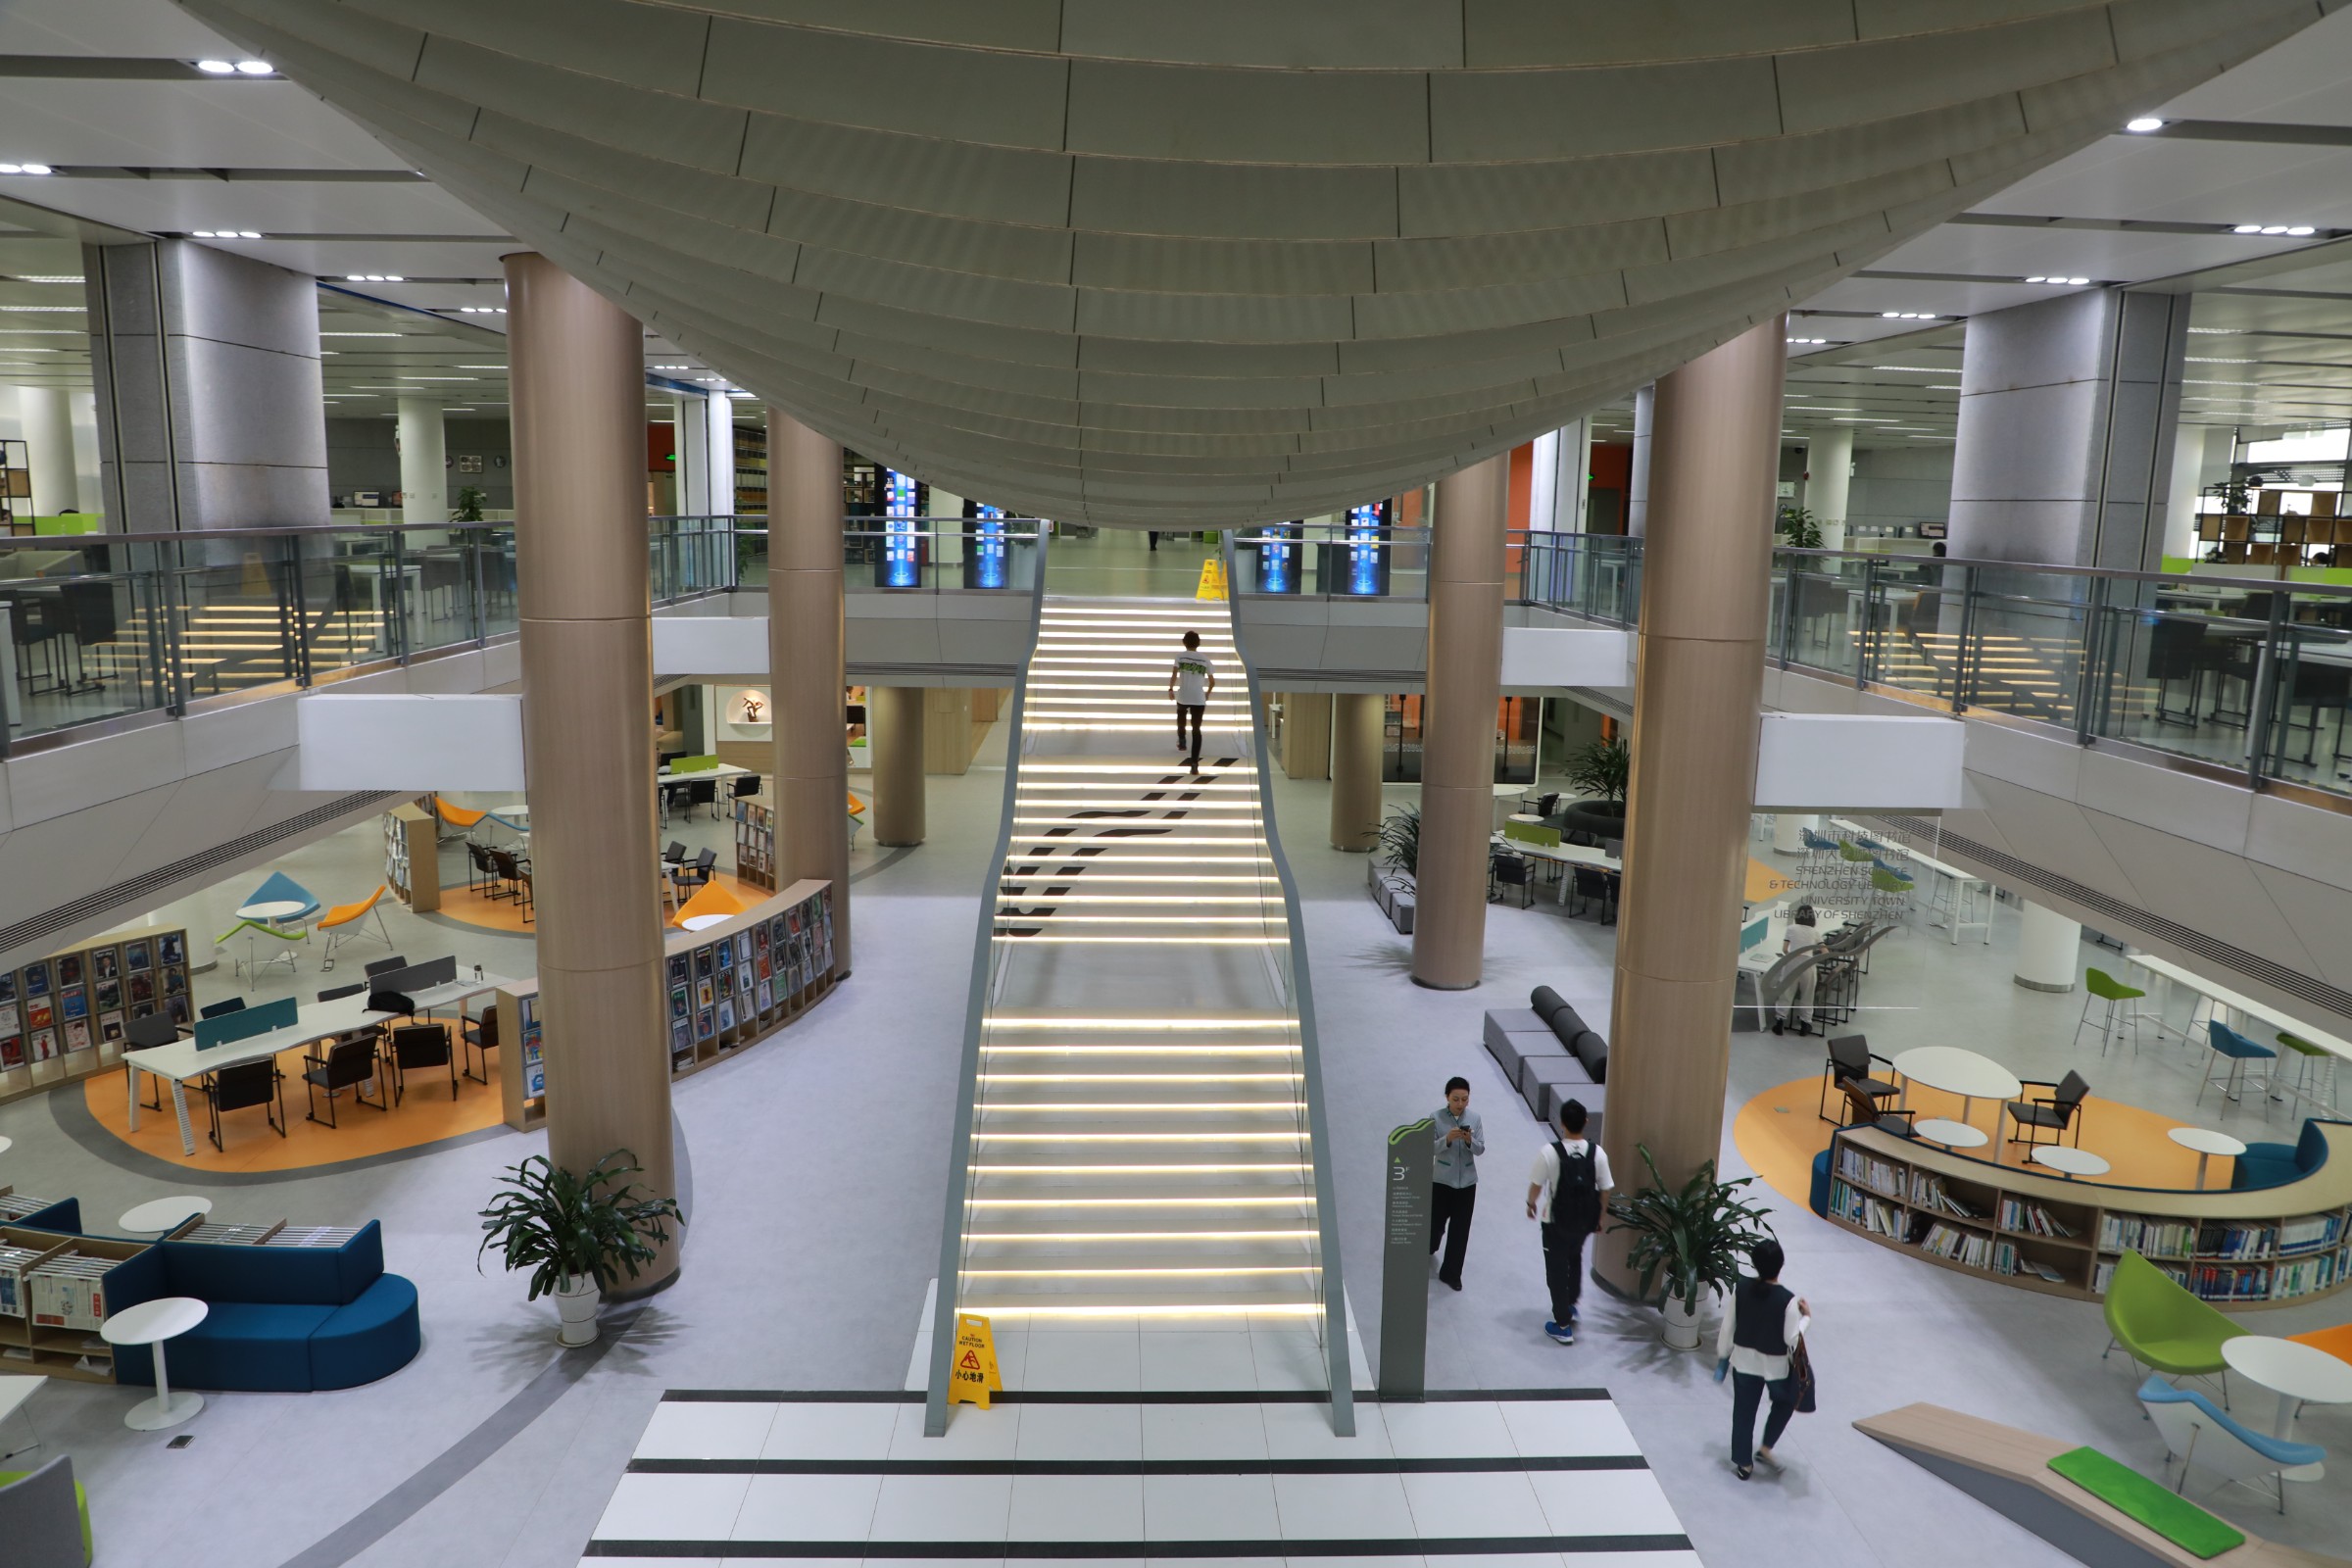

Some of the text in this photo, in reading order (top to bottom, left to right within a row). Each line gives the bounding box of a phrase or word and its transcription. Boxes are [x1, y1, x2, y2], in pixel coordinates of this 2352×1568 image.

[1796, 847, 1910, 861] 深圳大城图书馆
[1795, 865, 1908, 876] SHENZHEN SCIECE
[1769, 880, 1779, 889] &
[1781, 879, 1855, 890] TECHNOLOGY
[1800, 896, 1905, 906] UNIVERSITY TOWN
[1774, 909, 1903, 920] LIBRARY OF SHENZHEN
[956, 1369, 984, 1384] 小心地滑
